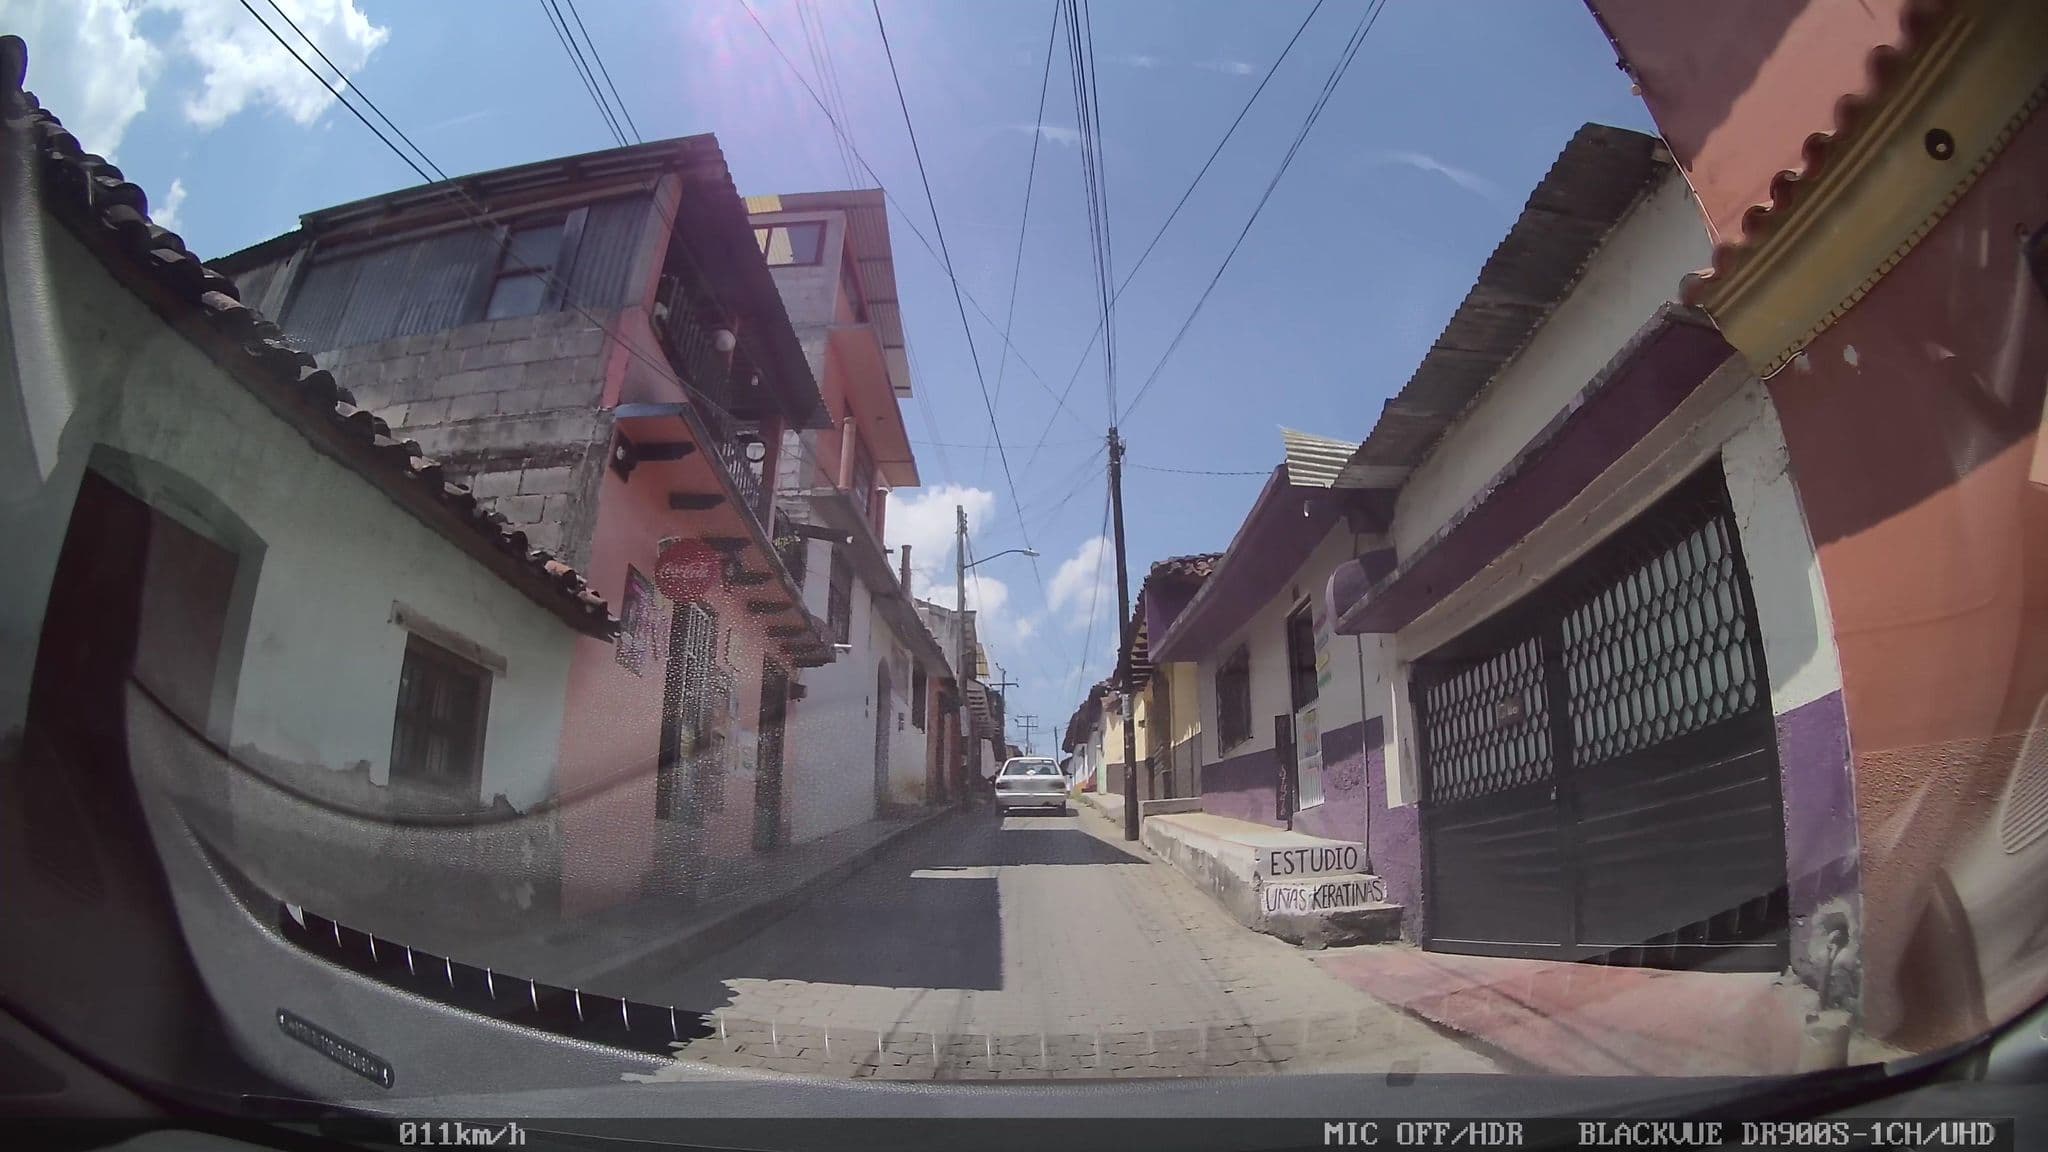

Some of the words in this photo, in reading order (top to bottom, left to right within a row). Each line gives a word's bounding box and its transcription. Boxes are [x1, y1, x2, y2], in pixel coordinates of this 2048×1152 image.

[1271, 846, 1358, 876] ESTUDIO
[1266, 886, 1307, 912] UÑAS
[1312, 880, 1384, 910] KERATINAS
